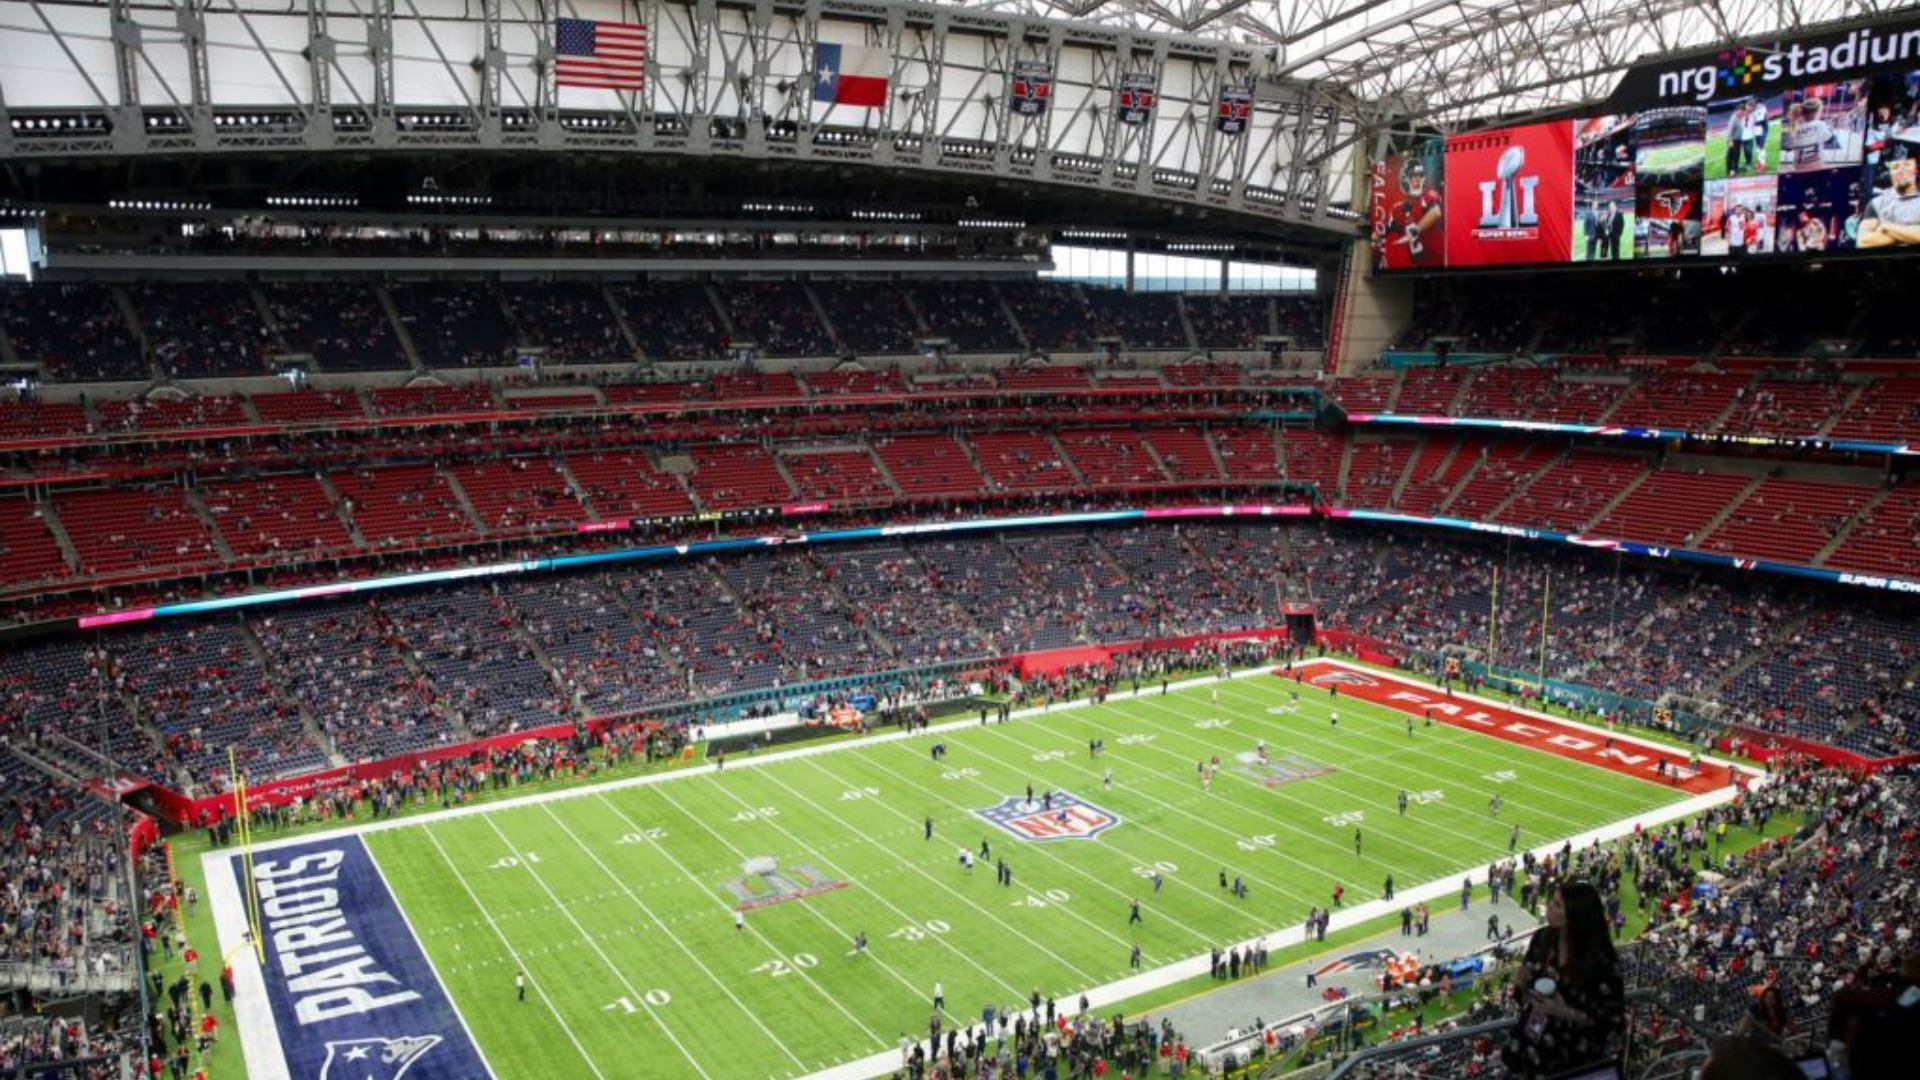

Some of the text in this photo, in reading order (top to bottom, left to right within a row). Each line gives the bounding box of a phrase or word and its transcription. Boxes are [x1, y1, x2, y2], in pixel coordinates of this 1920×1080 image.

[1659, 66, 1717, 101] nrg
[1838, 573, 1887, 589] SUPER
[1389, 691, 1703, 780] FALCONS
[1007, 806, 1110, 838] NFL
[254, 849, 424, 1026] PATRIOTS
[763, 952, 819, 978] 20
[616, 987, 672, 1015] 10
